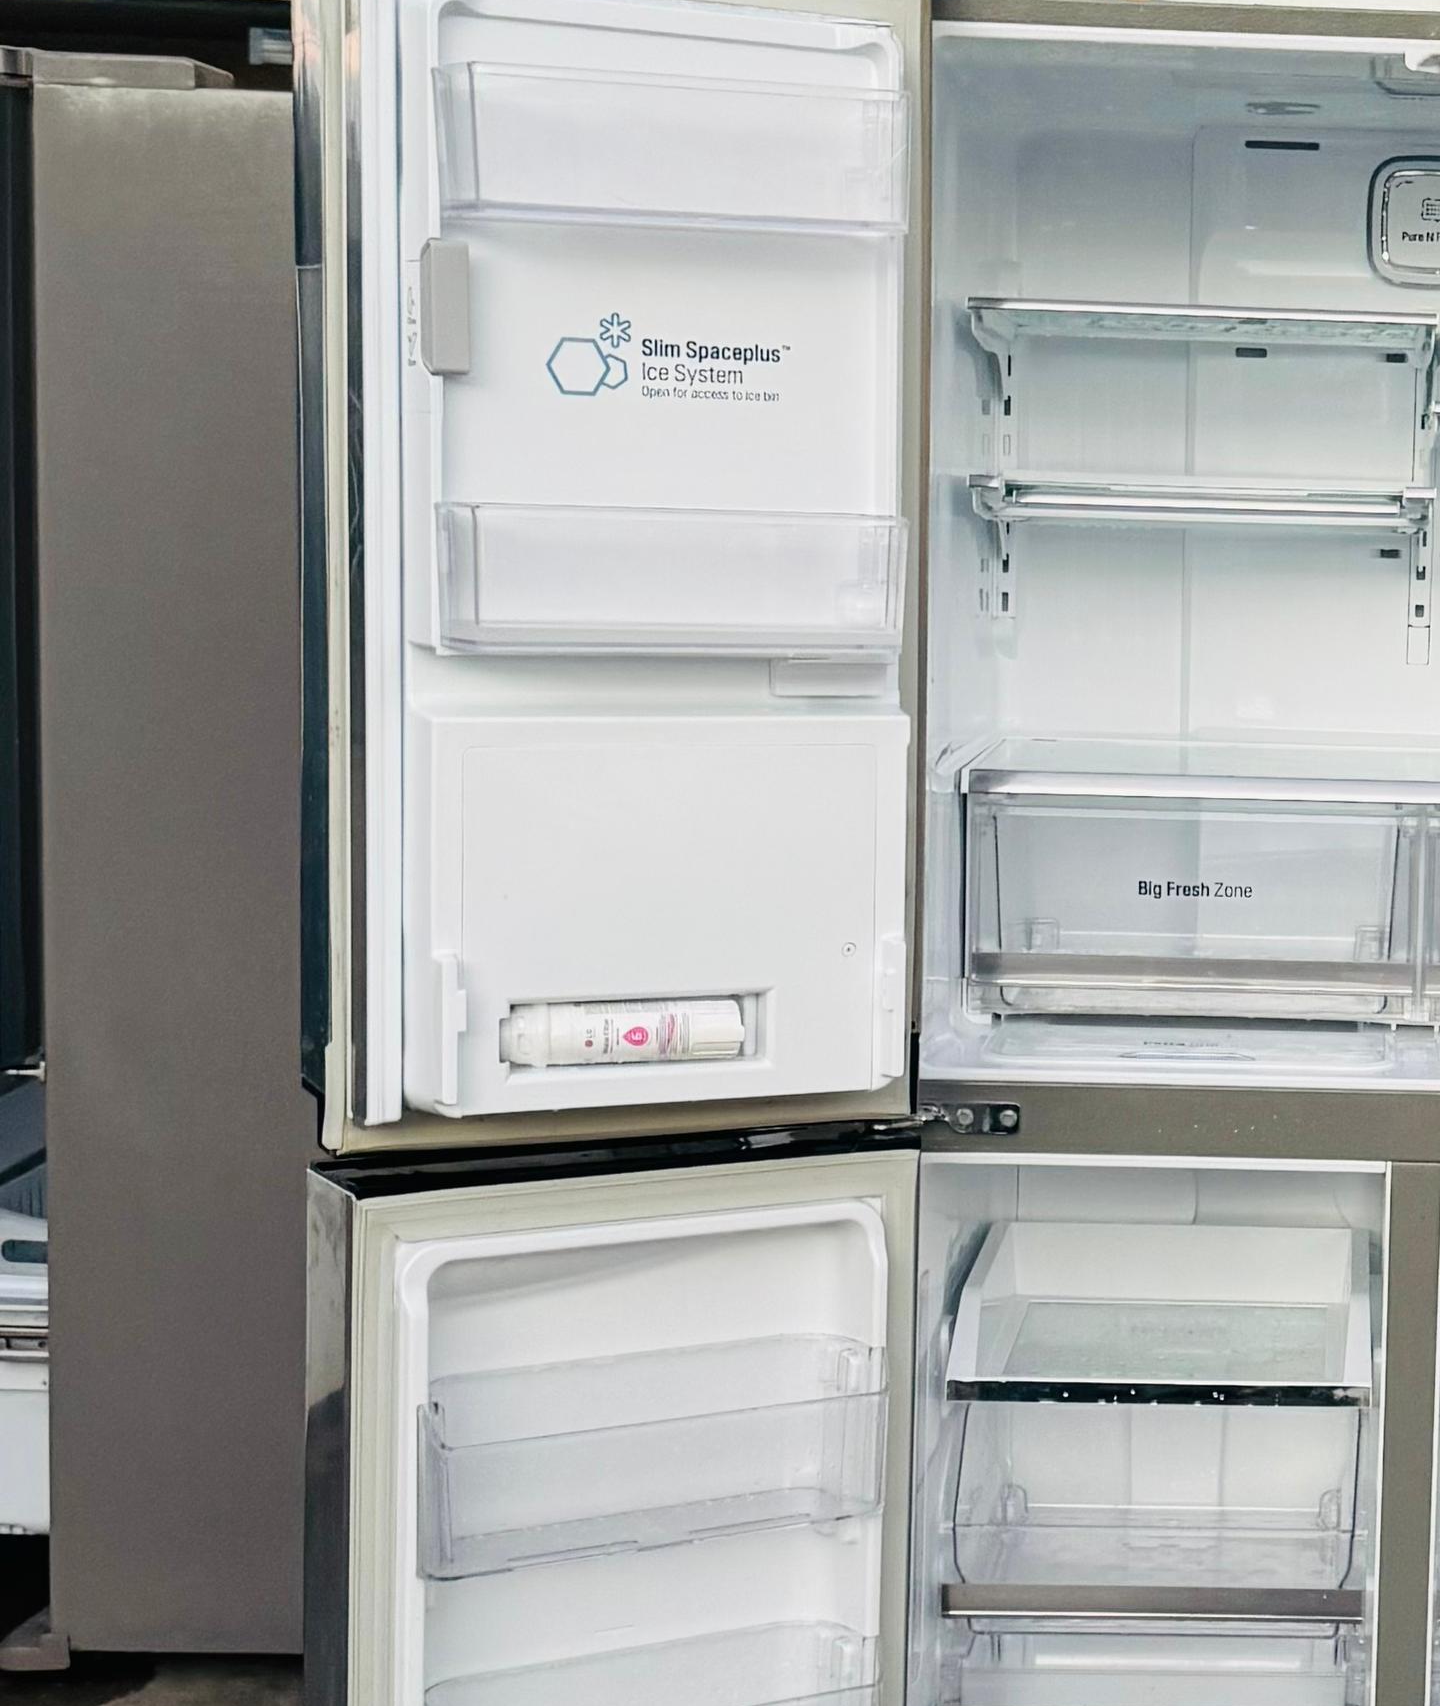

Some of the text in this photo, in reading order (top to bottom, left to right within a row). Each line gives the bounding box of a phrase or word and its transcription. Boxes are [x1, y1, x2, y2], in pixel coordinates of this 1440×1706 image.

[1402, 231, 1424, 242] Pure
[1426, 232, 1434, 242] N
[641, 338, 680, 358] Slim
[642, 362, 743, 386] Ice System
[641, 385, 670, 399] Open
[673, 386, 687, 398] for
[691, 389, 729, 400] access
[732, 390, 743, 401] to
[1138, 880, 1253, 899] Big Fresh Zone
